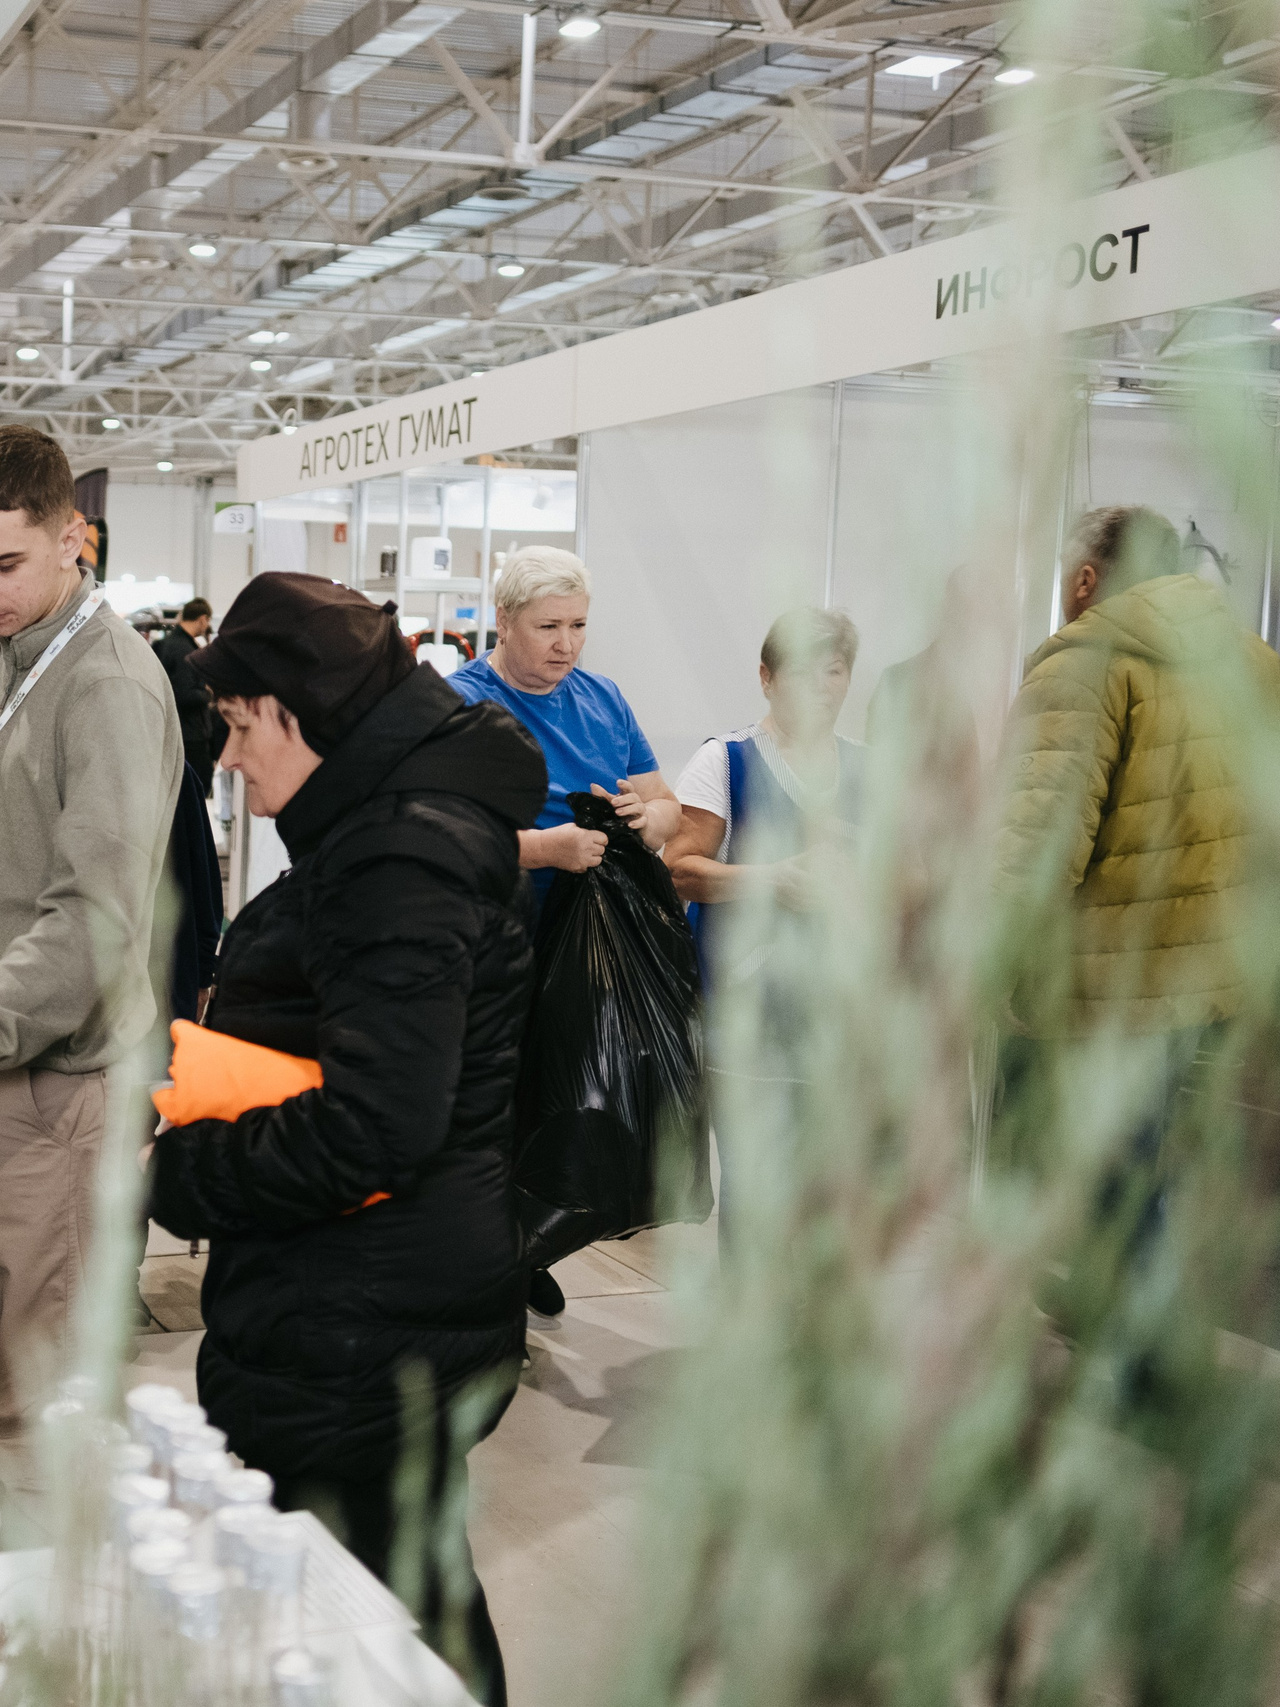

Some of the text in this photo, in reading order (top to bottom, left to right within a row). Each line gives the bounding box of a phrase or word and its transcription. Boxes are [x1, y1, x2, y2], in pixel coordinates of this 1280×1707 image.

[300, 397, 478, 479] АГРОТЕХ ГУМАТ
[230, 512, 244, 524] 33
